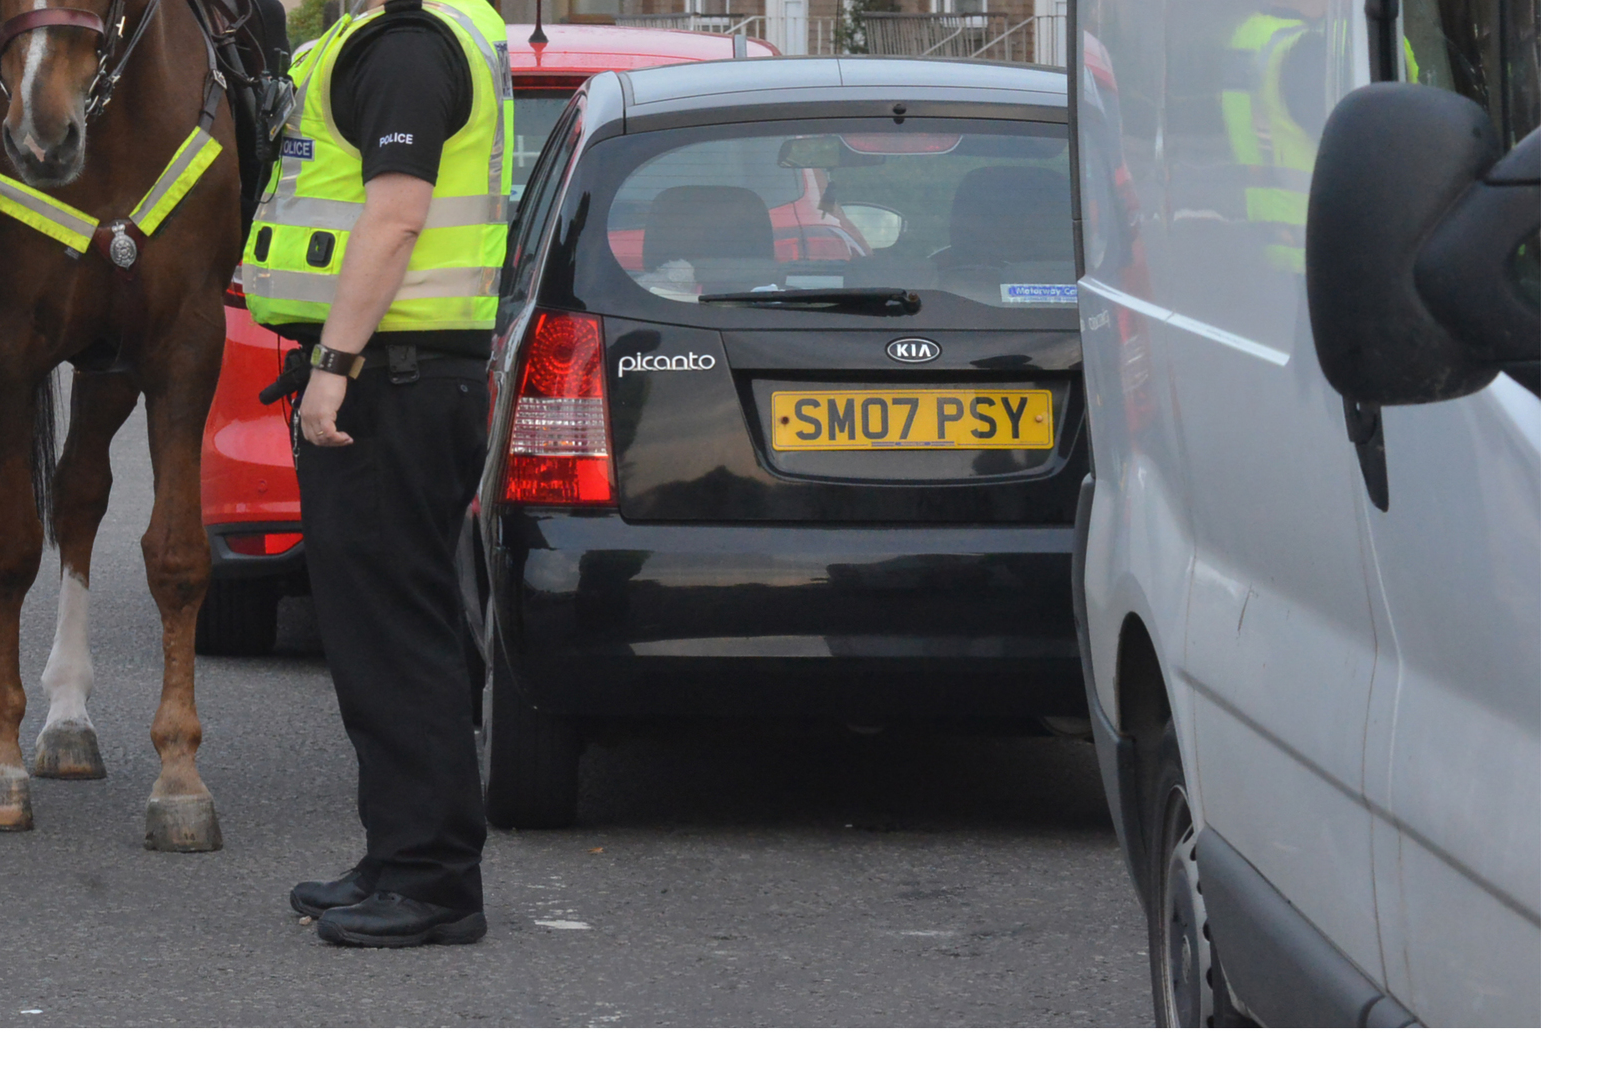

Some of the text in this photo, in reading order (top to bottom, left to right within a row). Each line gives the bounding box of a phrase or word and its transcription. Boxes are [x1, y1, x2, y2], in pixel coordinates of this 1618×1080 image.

[283, 139, 311, 156] OLICE
[379, 132, 414, 148] POLICE
[1015, 286, 1061, 297] Motorway
[896, 343, 932, 358] KIA
[618, 351, 716, 378] picanto
[794, 396, 1028, 441] SM07 PSY
